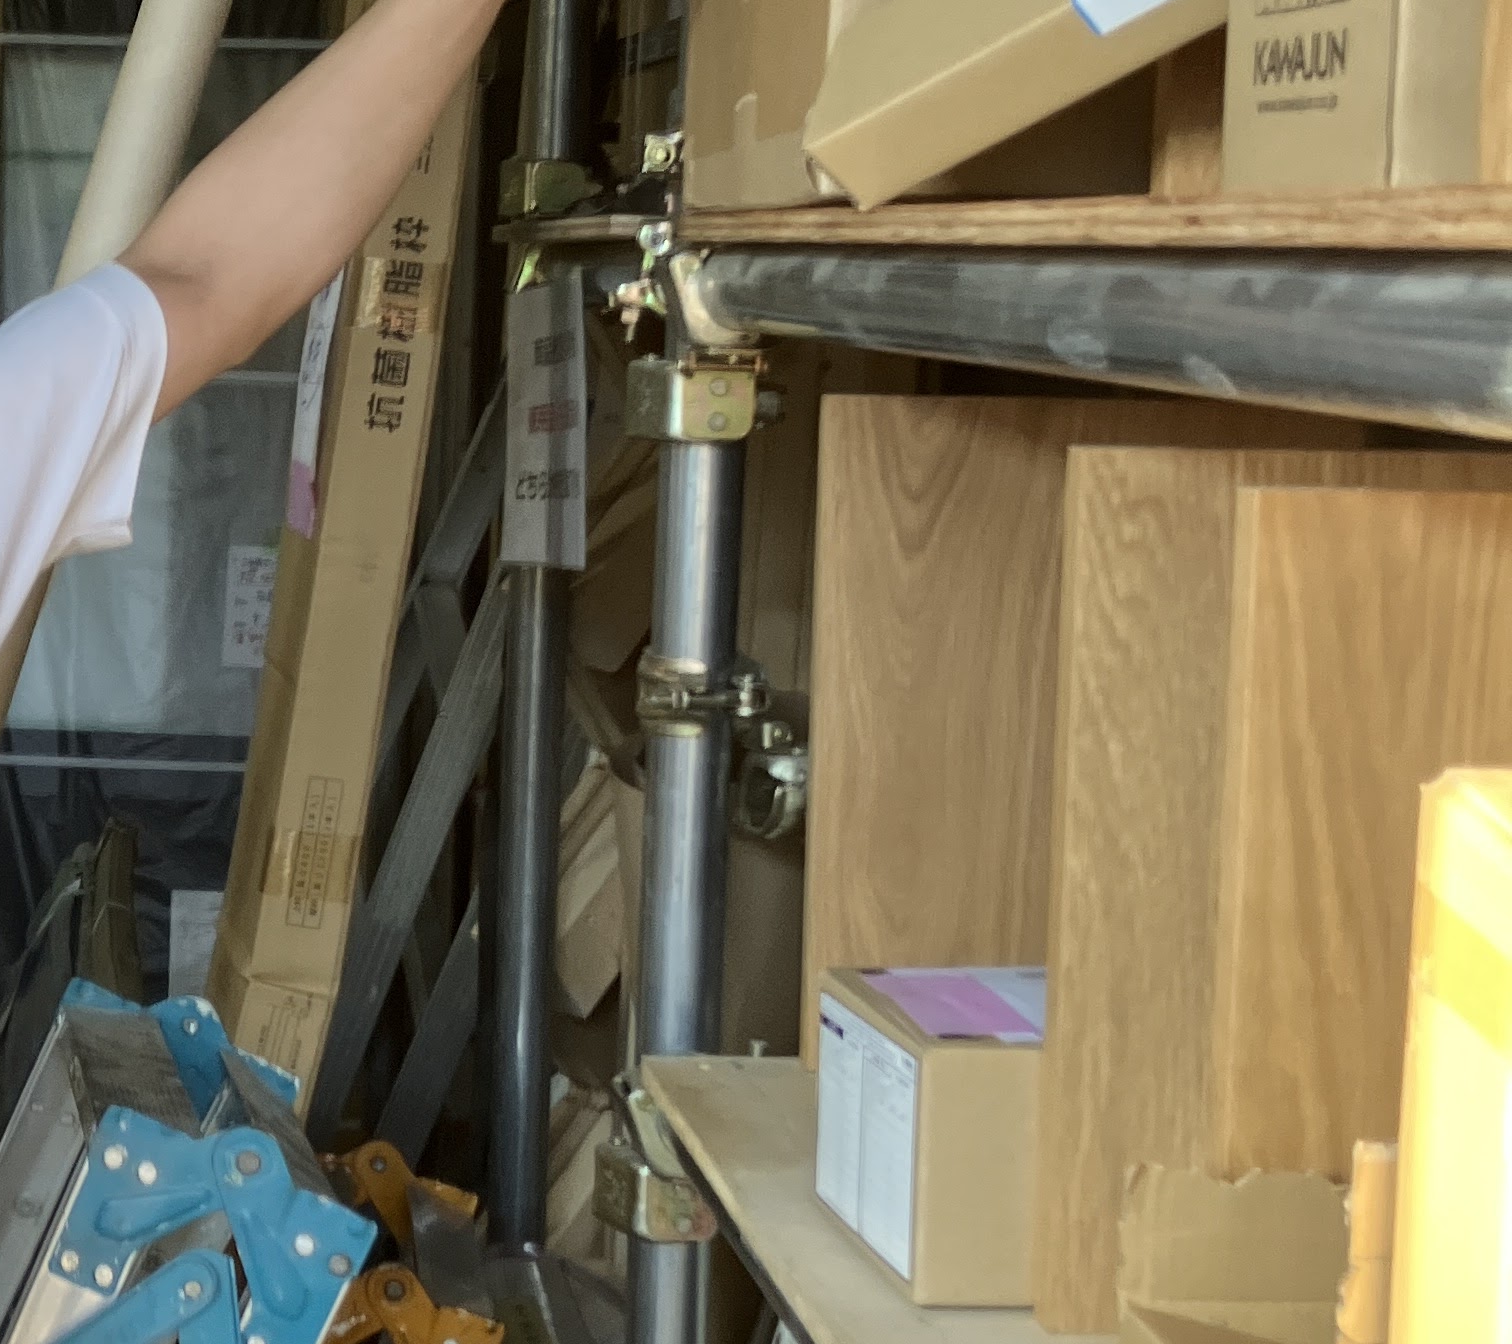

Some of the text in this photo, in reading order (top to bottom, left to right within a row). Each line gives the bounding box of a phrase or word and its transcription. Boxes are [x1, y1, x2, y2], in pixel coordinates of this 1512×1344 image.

[1253, 27, 1348, 86] KAWAJUN
[364, 216, 430, 433] 抗菌樹脂枠
